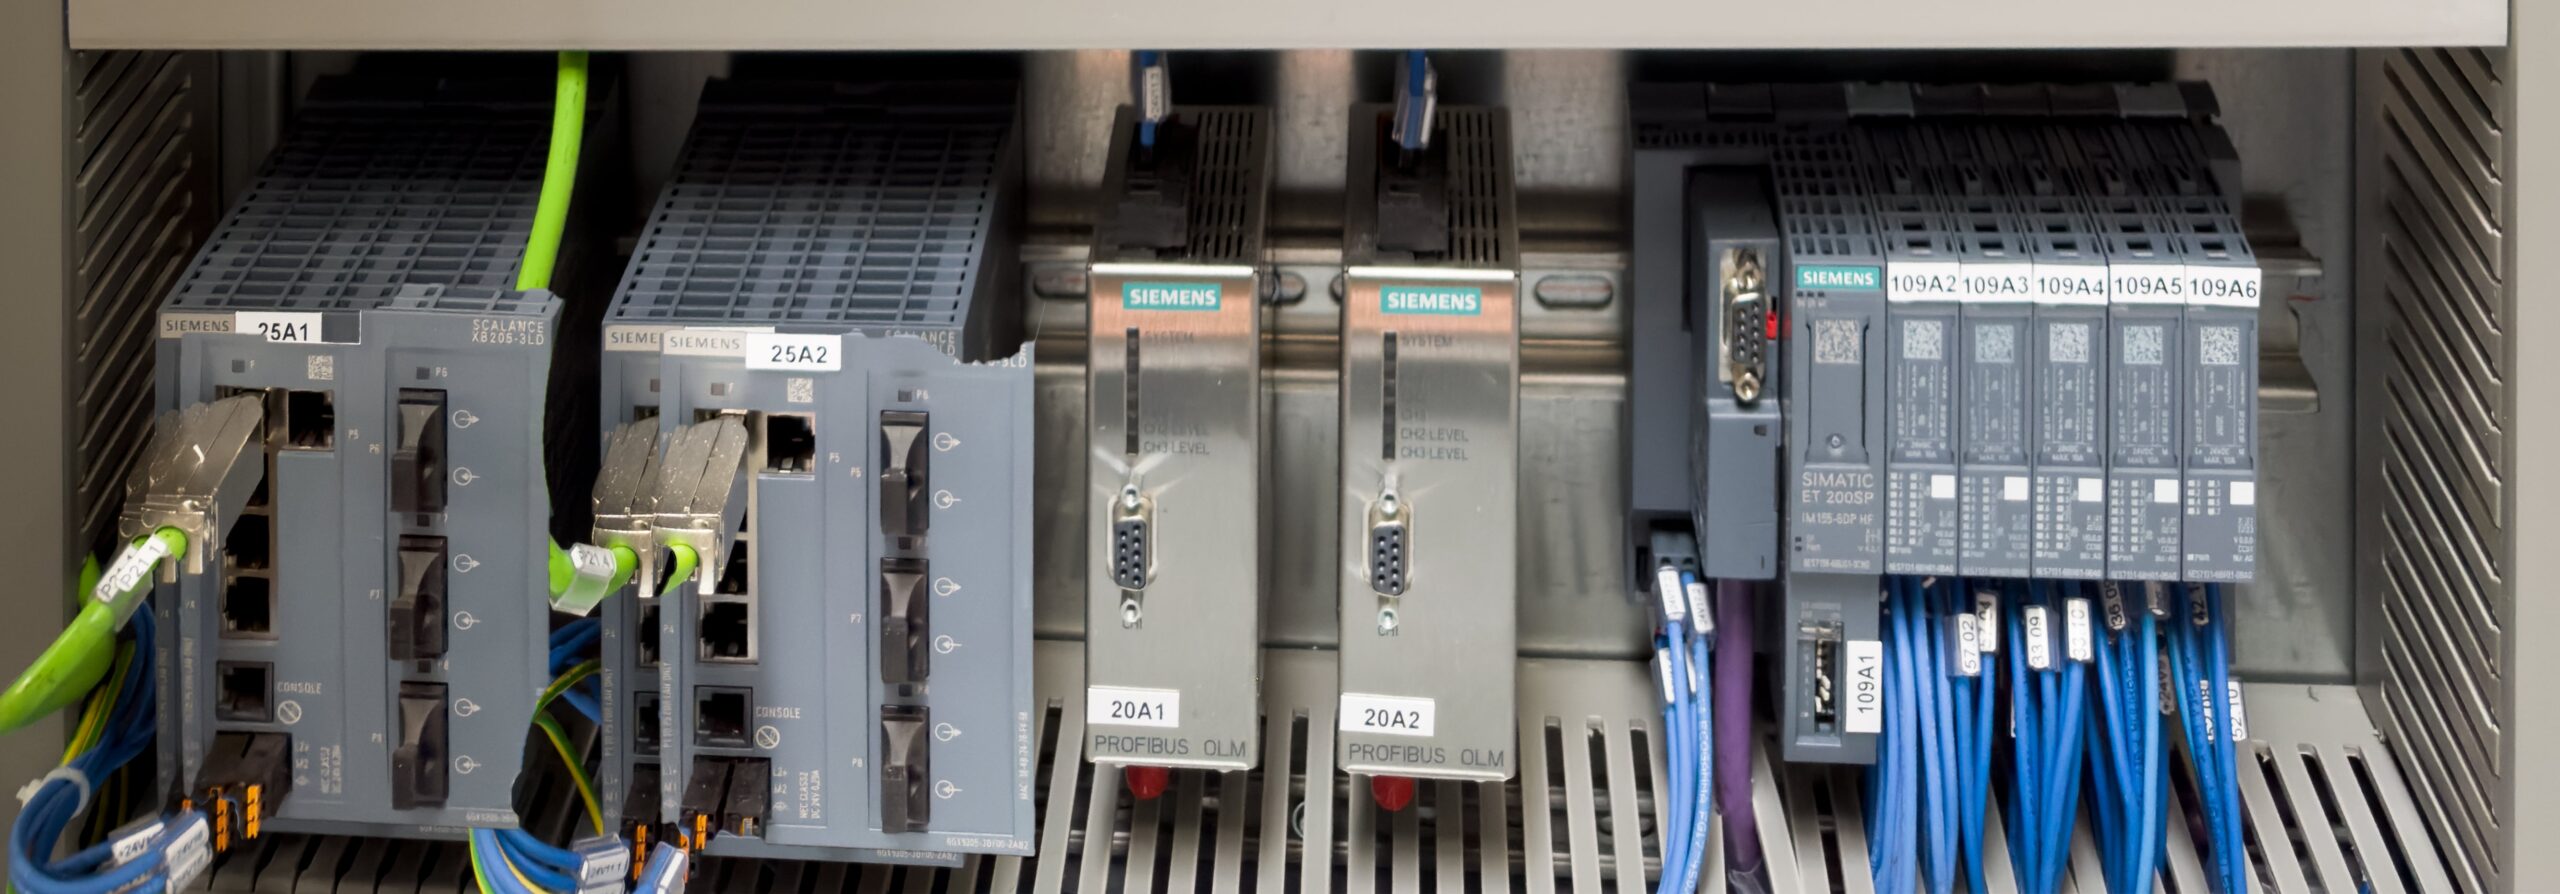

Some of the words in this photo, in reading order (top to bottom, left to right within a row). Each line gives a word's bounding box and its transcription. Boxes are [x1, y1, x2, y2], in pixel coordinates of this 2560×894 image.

[1803, 271, 1874, 286] SIEMENS
[1892, 275, 1957, 293] 109A2
[1962, 276, 2029, 294] 109A3
[2038, 277, 2104, 296] 109A4
[2114, 277, 2182, 295] 109A5
[1130, 288, 1217, 306] SIEMENS
[2189, 279, 2257, 298] 109A6
[1387, 292, 1477, 311] SIEMENS
[166, 320, 229, 332] SIEMENS
[258, 322, 309, 342] 25A1
[472, 318, 545, 334] SCALANCE
[611, 331, 658, 344] SIEME
[670, 336, 741, 350] SIEMENS
[771, 345, 828, 364] 25A2
[1400, 428, 1425, 440] CH2
[1430, 428, 1469, 442] LEVEL
[1171, 442, 1210, 456] LEVEL
[1430, 447, 1469, 461] LEVEL
[1802, 472, 1874, 488] SIMATIC
[1802, 490, 1821, 503] ET
[1826, 490, 1874, 505] 200SP
[1859, 513, 1874, 524] HF
[277, 682, 322, 695] CONSOLE
[1857, 655, 1875, 714] 109A1
[756, 706, 801, 719] CONSOLE
[1111, 700, 1164, 720] 20A1
[1364, 708, 1420, 729] 20A2
[1095, 735, 1189, 755] PROFIBUS
[1204, 739, 1247, 758] OLM
[1349, 743, 1446, 764] PROFIBUS
[1460, 749, 1504, 768] OLM
